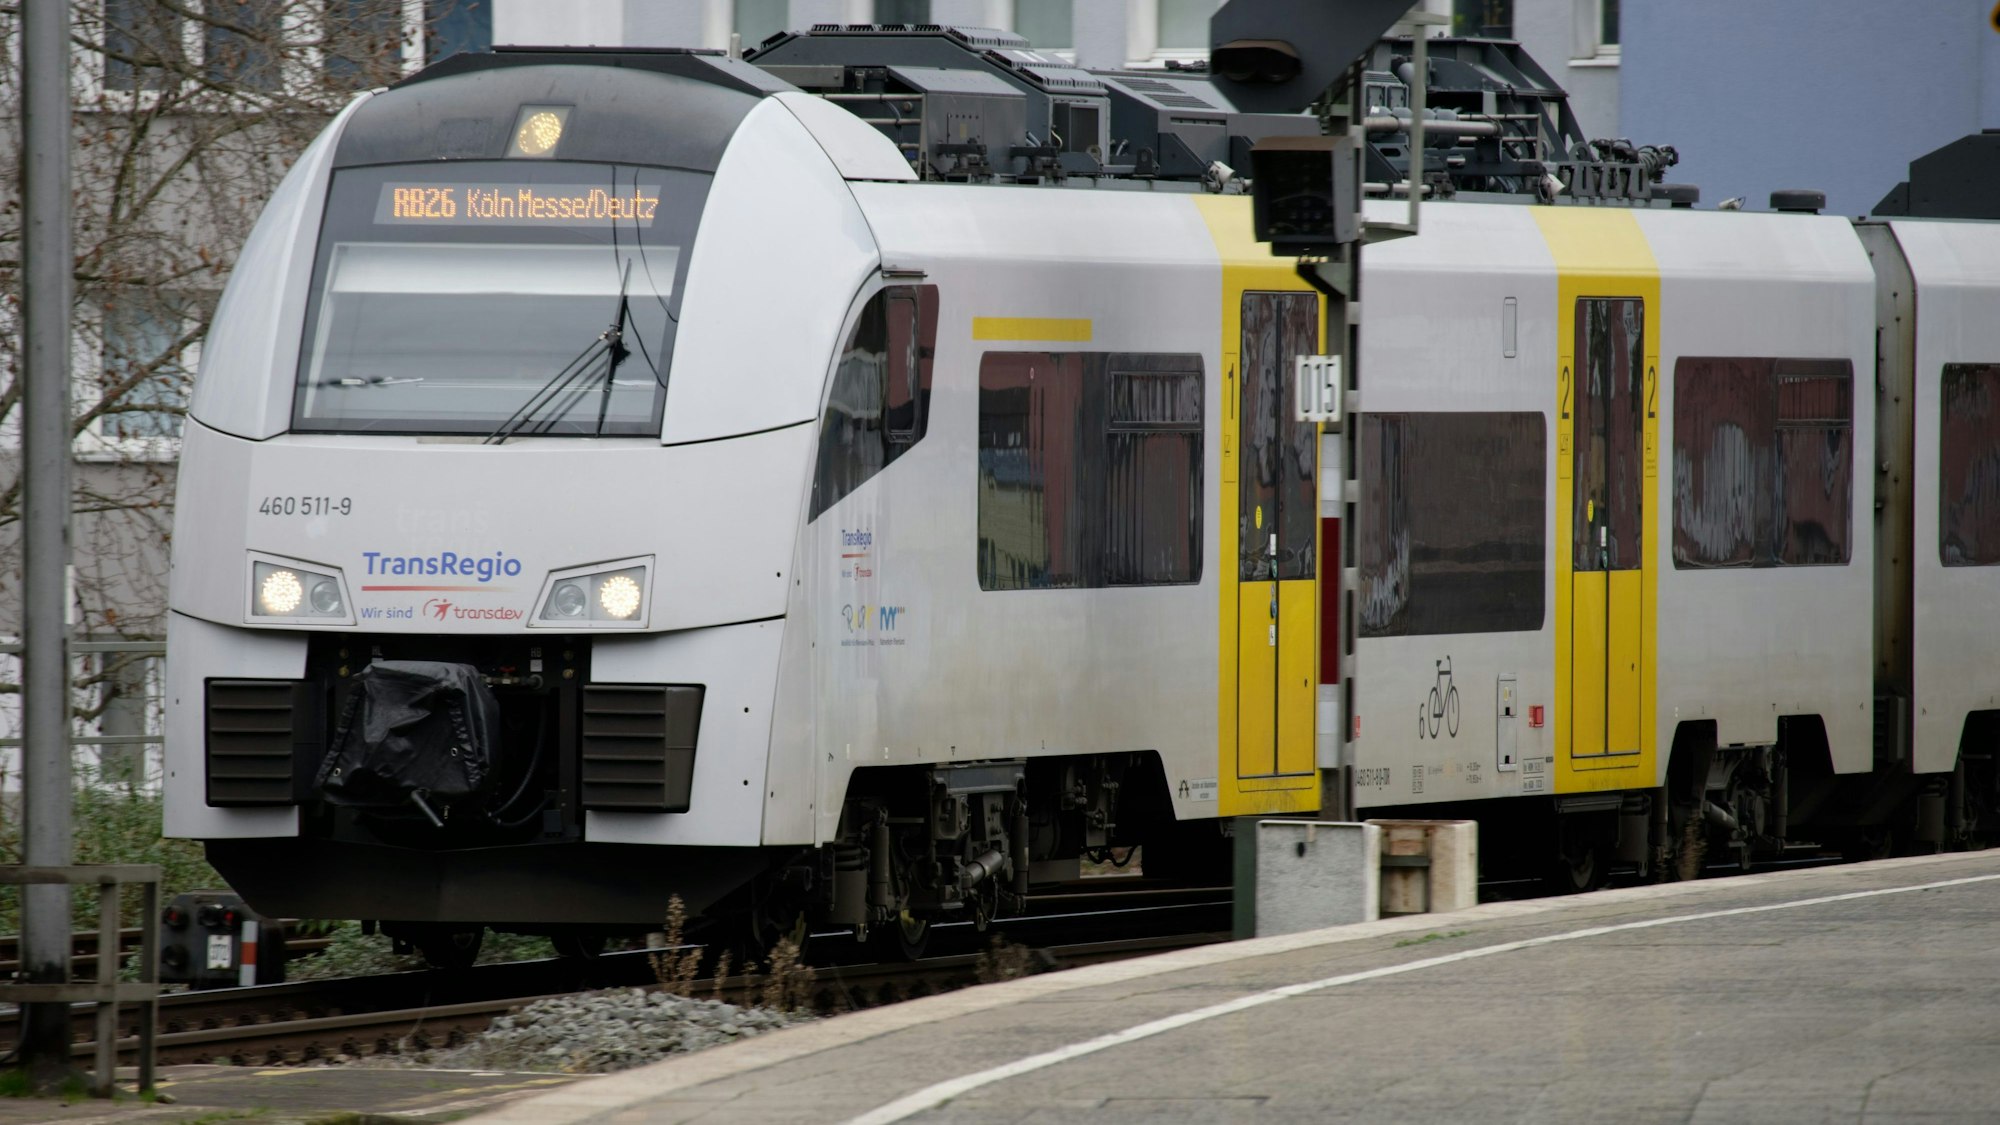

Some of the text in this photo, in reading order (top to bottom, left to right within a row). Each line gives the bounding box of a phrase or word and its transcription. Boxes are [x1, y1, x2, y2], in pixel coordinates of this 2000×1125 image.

[393, 188, 659, 218] RB26 Köln Messe/Deutz
[1228, 362, 1234, 420] 1
[1562, 366, 1570, 419] 2
[1648, 366, 1656, 418] 2
[259, 497, 352, 516] 460 511-9
[362, 551, 522, 583] TransRegio
[361, 606, 413, 619] Wir sind
[454, 606, 524, 620] transdev
[1419, 703, 1425, 740] 6
